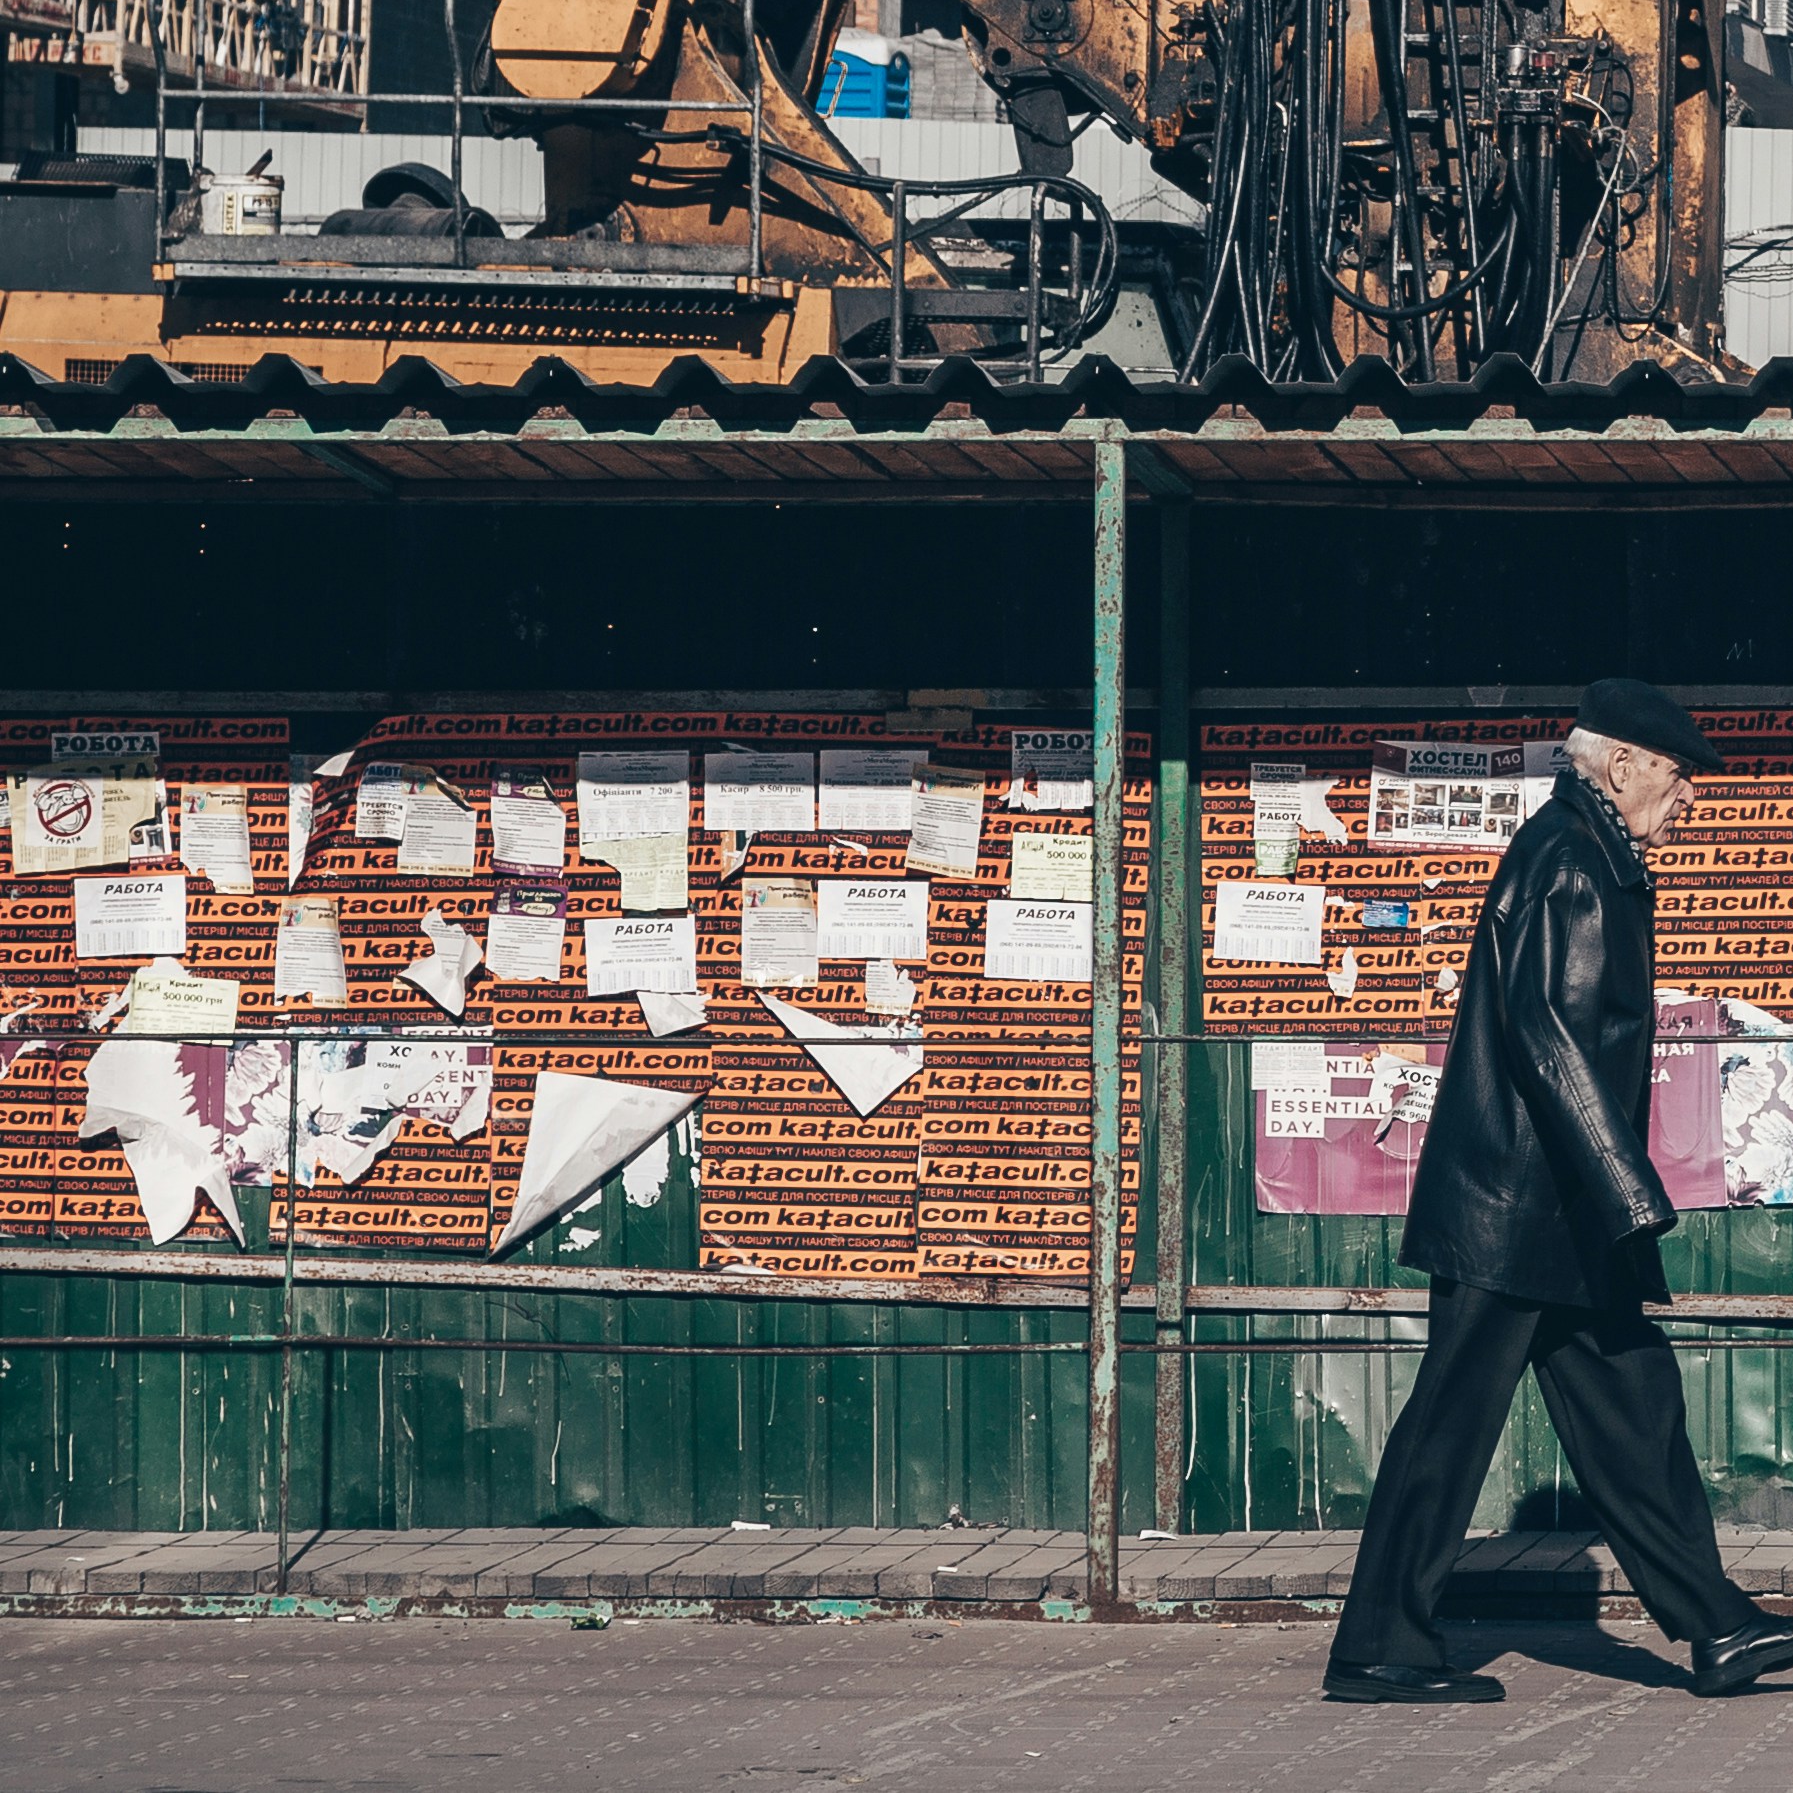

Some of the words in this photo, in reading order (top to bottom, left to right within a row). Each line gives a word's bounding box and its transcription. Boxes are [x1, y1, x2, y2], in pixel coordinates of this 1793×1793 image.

[54, 735, 158, 753] РОБОТА
[1409, 750, 1488, 767] ХОСТЕЛ
[1495, 752, 1521, 767] 140
[657, 787, 673, 795] 200
[720, 784, 750, 796] Касир
[766, 785, 783, 793] 500
[104, 882, 164, 895] РАБОТА
[847, 888, 907, 899] РАБОТА
[1246, 890, 1306, 903] РАБОТА
[1016, 908, 1076, 920] РАБОТА
[615, 923, 674, 936] РАБОТА
[163, 992, 184, 1002] 500
[187, 993, 207, 1003] 000
[966, 1010, 998, 1022] МІСЦЕ
[1000, 1010, 1020, 1022] ДЛЯ
[1021, 1011, 1079, 1023] ПОСТЕРІВ
[1272, 1100, 1387, 1115] ESSENTIAL
[704, 1117, 772, 1136] com
[1271, 1120, 1320, 1134] DAY.
